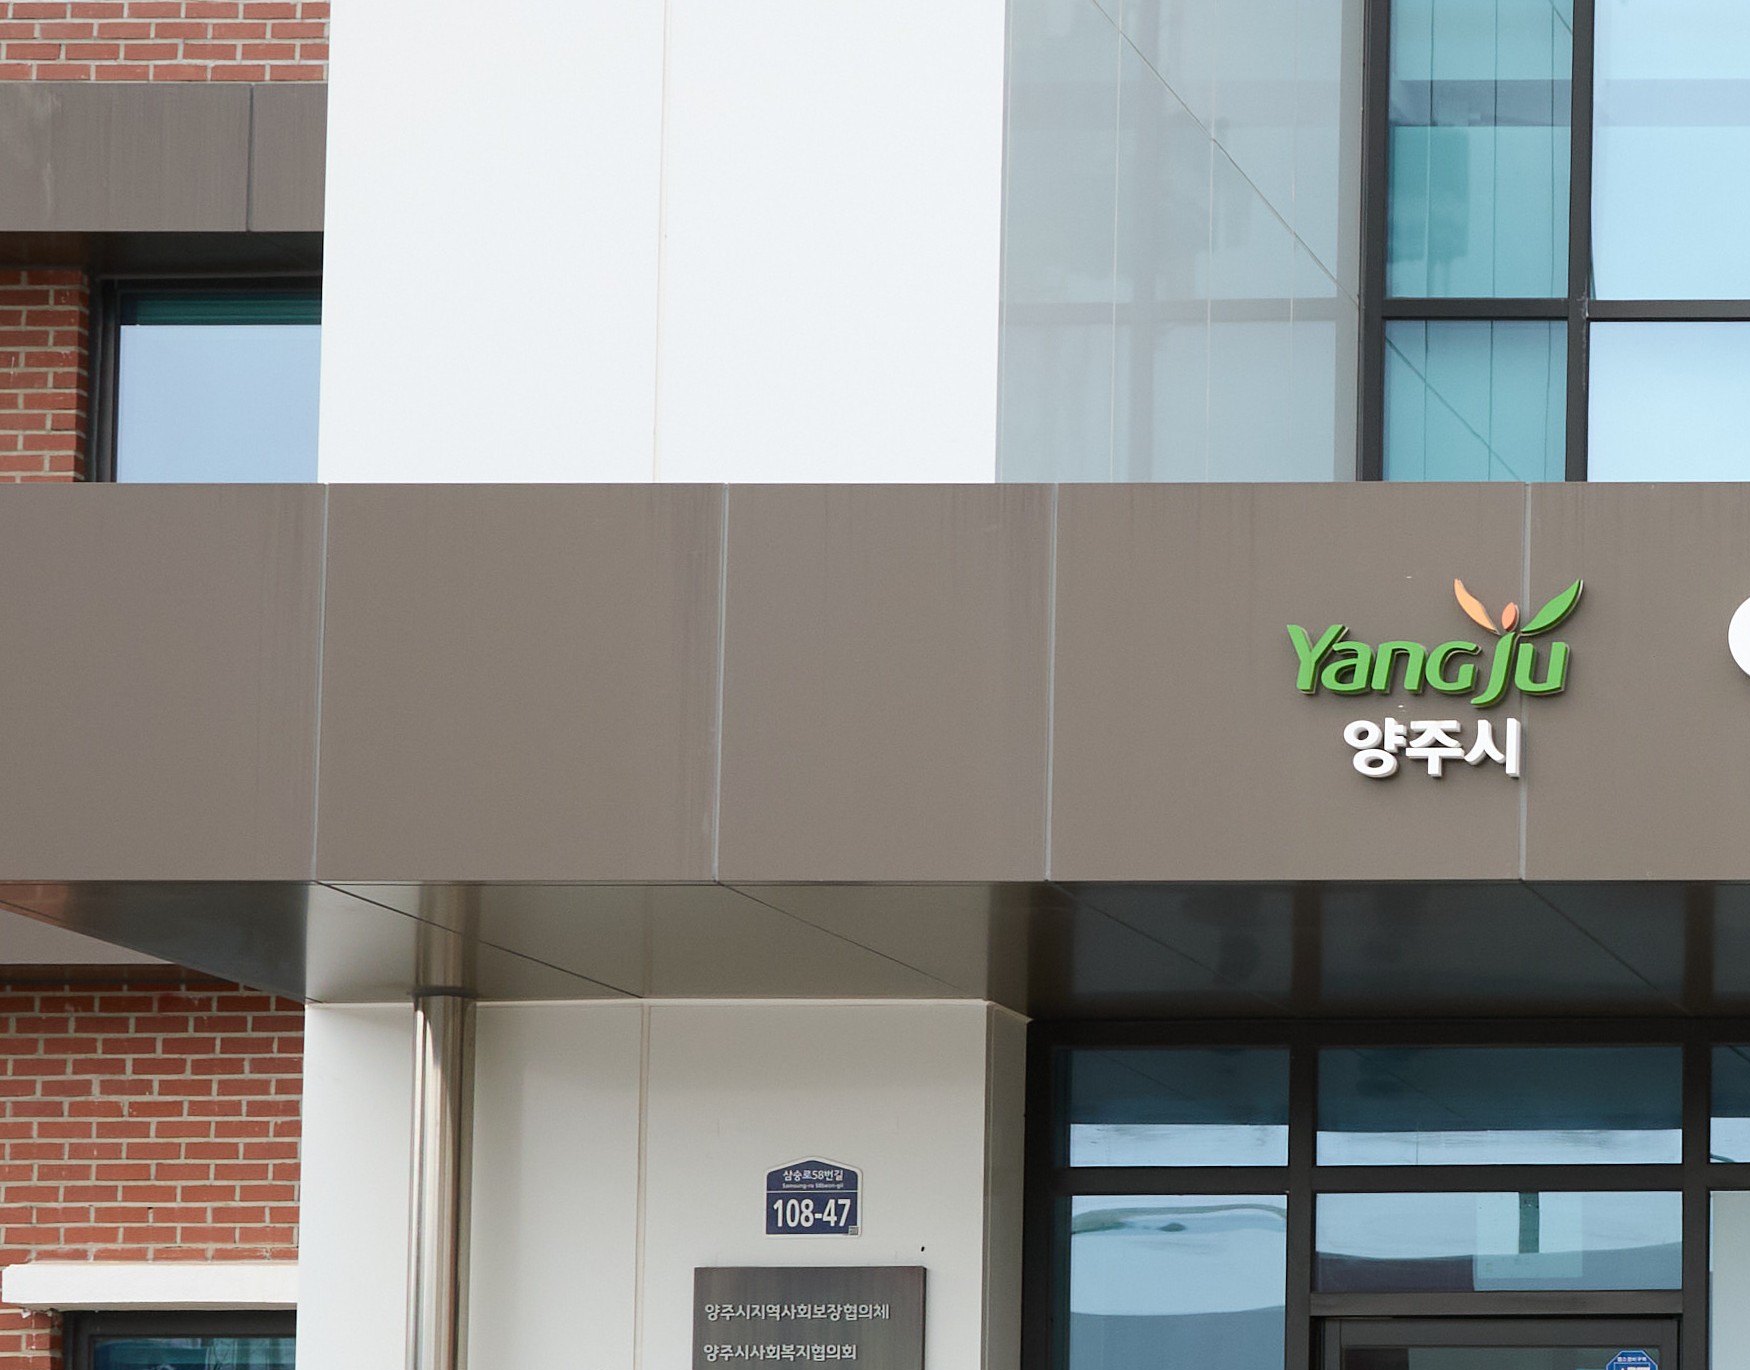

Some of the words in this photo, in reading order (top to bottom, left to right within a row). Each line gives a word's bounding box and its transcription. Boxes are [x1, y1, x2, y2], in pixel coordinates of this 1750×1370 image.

[1343, 717, 1521, 778] 양주시
[773, 1199, 851, 1227] 108-47
[704, 1303, 890, 1321] 양주시지역사회보장협의체
[703, 1344, 857, 1361] 양주시사회복지협의회
